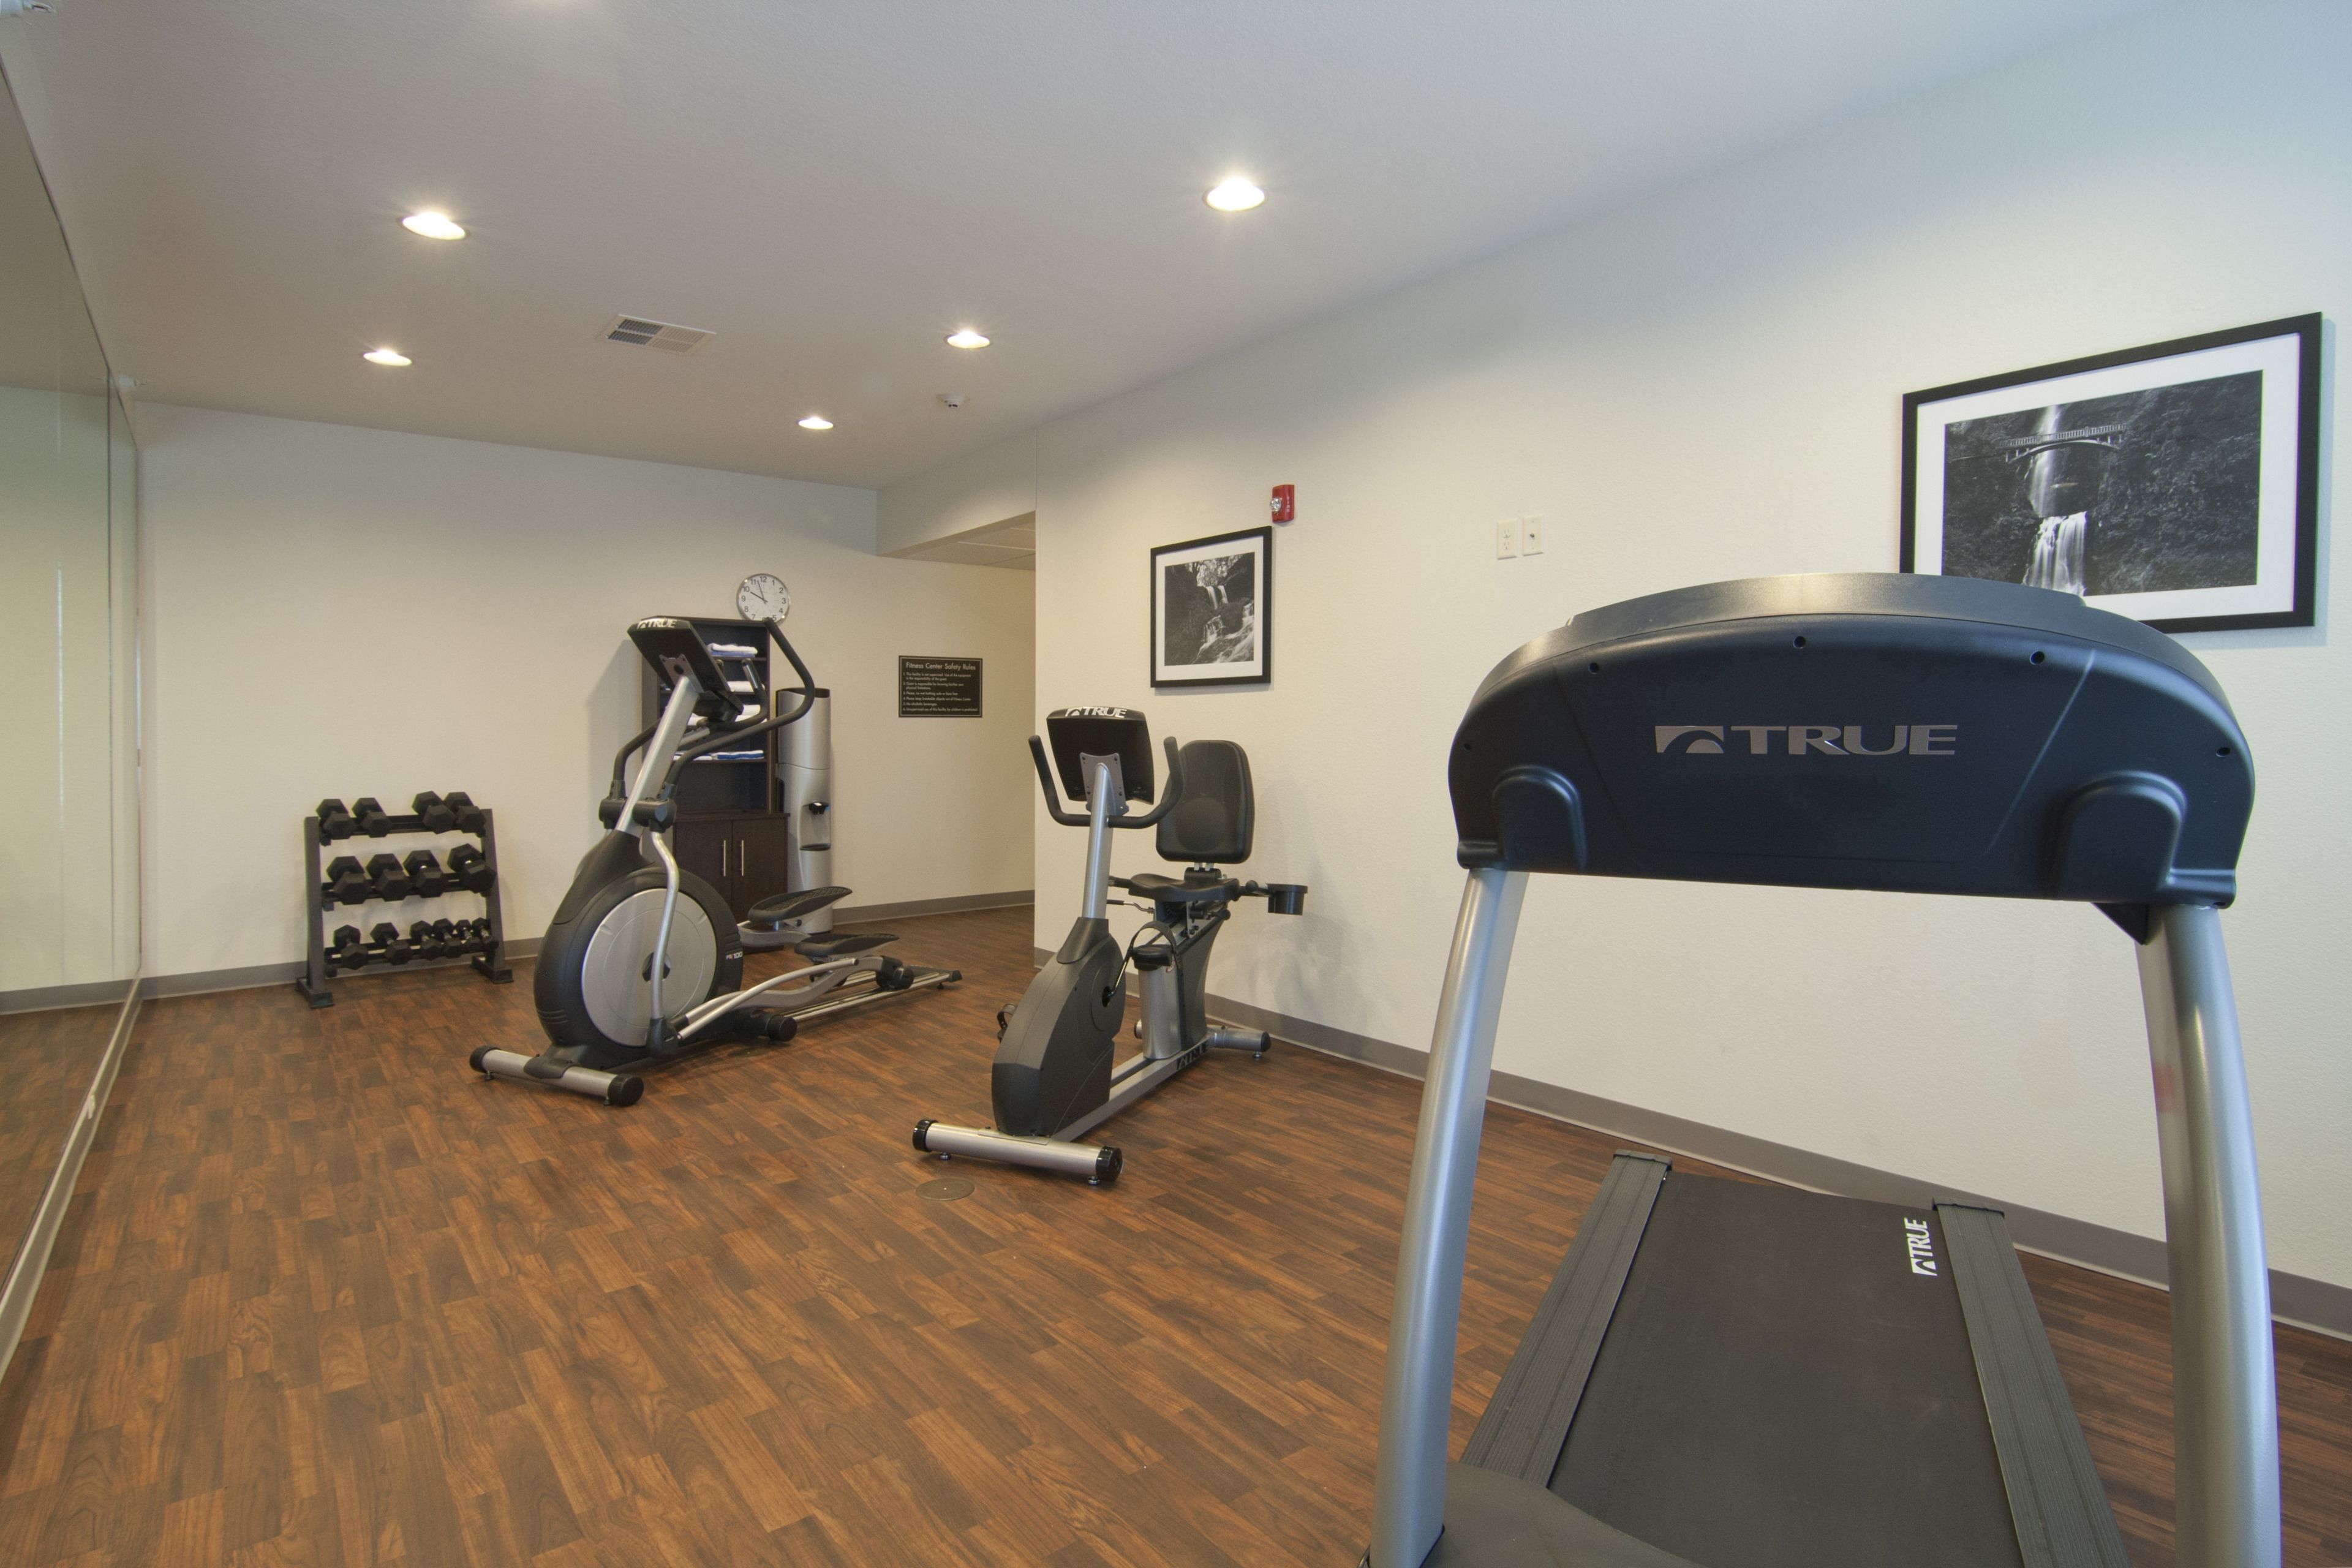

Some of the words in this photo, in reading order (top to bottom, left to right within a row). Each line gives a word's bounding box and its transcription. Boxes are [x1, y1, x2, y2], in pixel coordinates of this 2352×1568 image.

[647, 617, 677, 628] TRUE
[944, 663, 961, 671] Safety
[1082, 706, 1128, 718] TRUE
[1731, 725, 1958, 755] TRUE
[1904, 1217, 1934, 1258] TRUE
